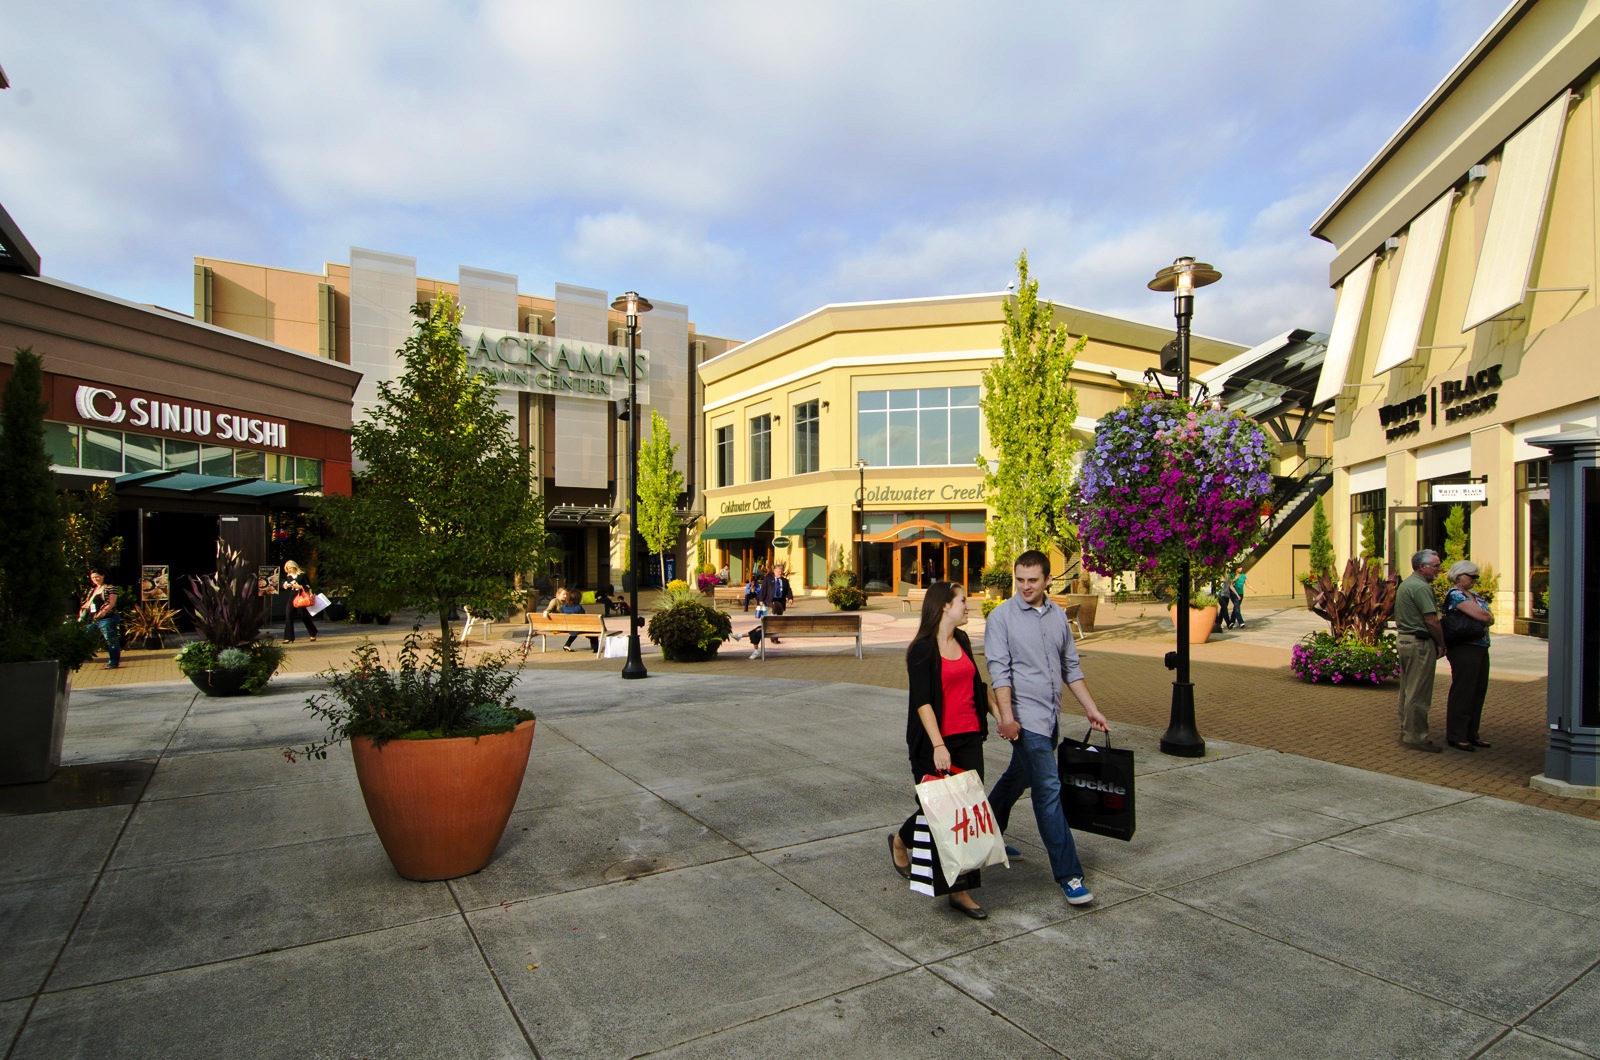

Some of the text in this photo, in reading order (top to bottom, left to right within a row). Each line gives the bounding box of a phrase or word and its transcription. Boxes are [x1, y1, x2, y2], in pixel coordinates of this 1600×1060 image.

[417, 329, 648, 381] ACKAMAS
[535, 372, 609, 395] CENTER
[1440, 364, 1503, 404] BLACK
[129, 397, 286, 448] SINJU SUSHI
[720, 495, 772, 514] Coldwater Creek
[854, 483, 986, 502] Coldwater Creek
[1063, 773, 1126, 796] Buckle
[950, 800, 995, 845] H&M
